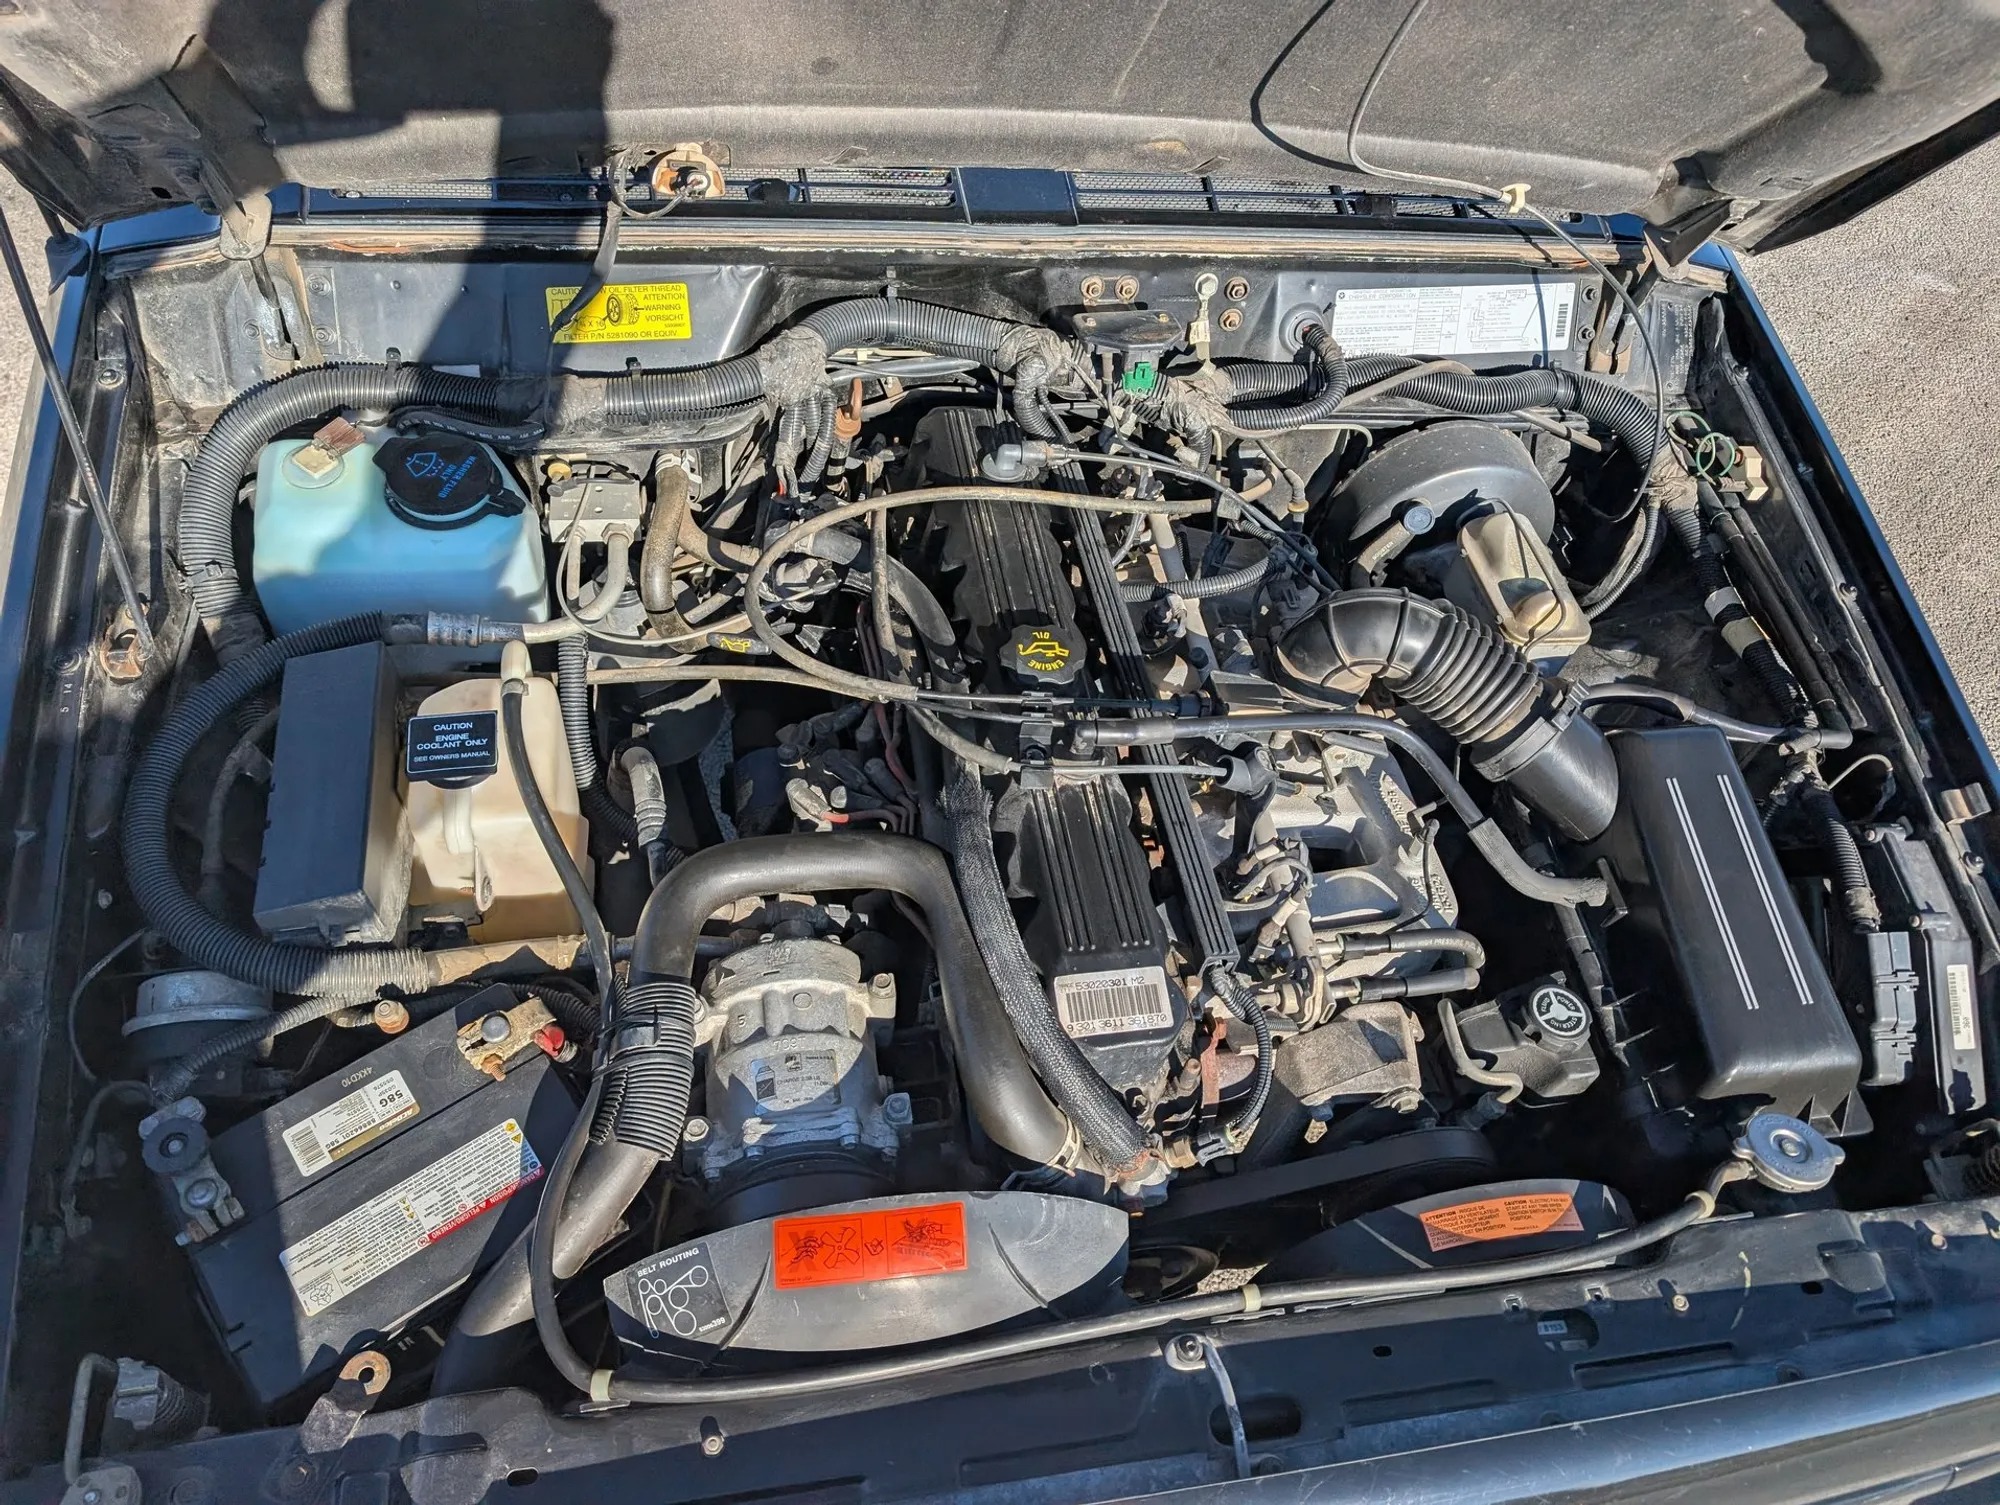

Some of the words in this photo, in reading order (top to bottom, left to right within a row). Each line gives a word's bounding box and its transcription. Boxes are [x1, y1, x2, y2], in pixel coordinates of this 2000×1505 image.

[551, 288, 579, 296] CAUTIO
[608, 286, 622, 294] OIL
[623, 285, 649, 293] FILTER
[650, 284, 681, 292] THREAD
[643, 293, 685, 301] ATTENTION
[644, 303, 682, 311] WARNING
[645, 314, 684, 322] VORSICHT
[564, 333, 589, 341] FILTER
[606, 331, 639, 339] 5281090
[640, 330, 653, 338] OR
[440, 463, 457, 481] ONLY
[452, 455, 478, 480] WASHER
[438, 479, 458, 498] FLUID
[1032, 631, 1050, 639] OIL
[1027, 659, 1065, 671] ENGINE
[433, 722, 473, 731] CAUTION
[435, 732, 470, 742] ENGINE
[417, 740, 462, 750] COOLANT
[465, 738, 488, 747] ONLY
[413, 755, 428, 763] SEE
[429, 752, 460, 761] OWNERS
[461, 750, 491, 758] MANUAL
[1075, 978, 1128, 991] 53020301
[1541, 997, 1551, 1013] FLUID
[1556, 995, 1576, 1011] POWER
[737, 1014, 747, 1027] 5
[1550, 1016, 1578, 1029] STEERING
[1066, 1024, 1074, 1033] 9
[341, 1066, 373, 1088] 4KKD10
[379, 1089, 403, 1107] 58G
[379, 1108, 413, 1131] ACDelco
[324, 1138, 339, 1149] 58G
[488, 1173, 535, 1203] DANGER/POISON
[430, 1206, 480, 1238] PELIGRO/VENENO
[1426, 1211, 1456, 1221] ATTENTION
[637, 1264, 657, 1277] BELT
[659, 1247, 700, 1269] ROUTING
